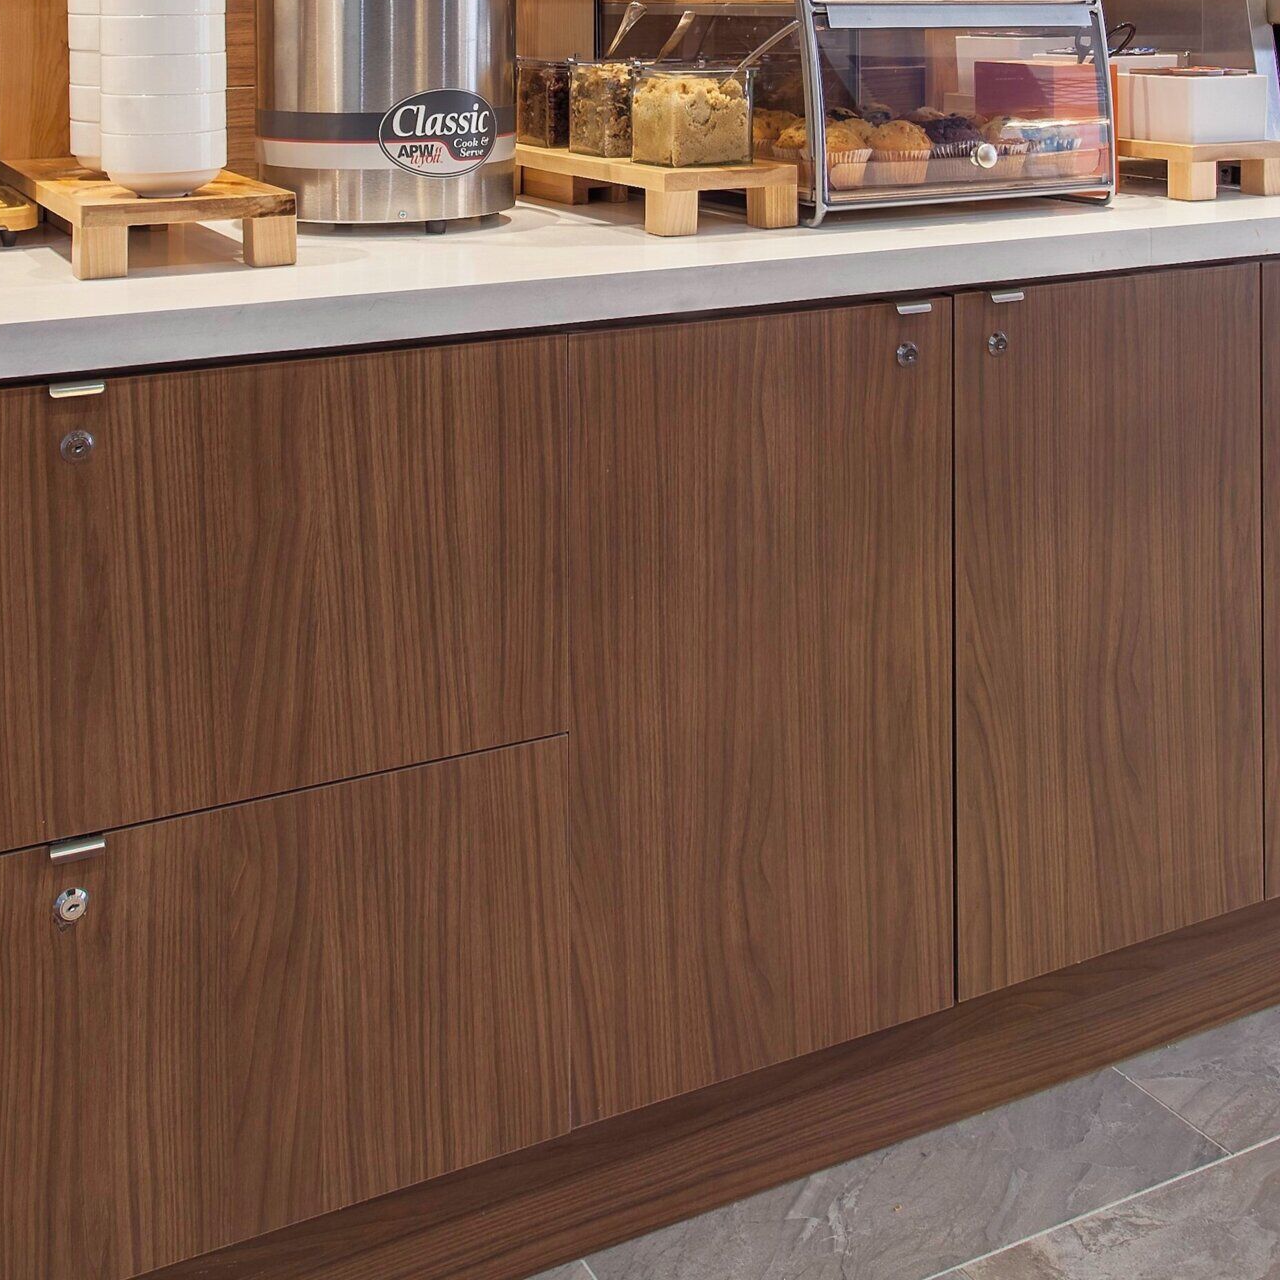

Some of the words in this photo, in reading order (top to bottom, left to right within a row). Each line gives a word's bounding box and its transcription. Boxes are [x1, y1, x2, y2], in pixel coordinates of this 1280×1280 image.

[392, 103, 490, 137] Classic
[453, 137, 479, 148] Cook
[480, 136, 489, 146] &
[397, 144, 434, 158] APW
[460, 148, 484, 157] Serve
